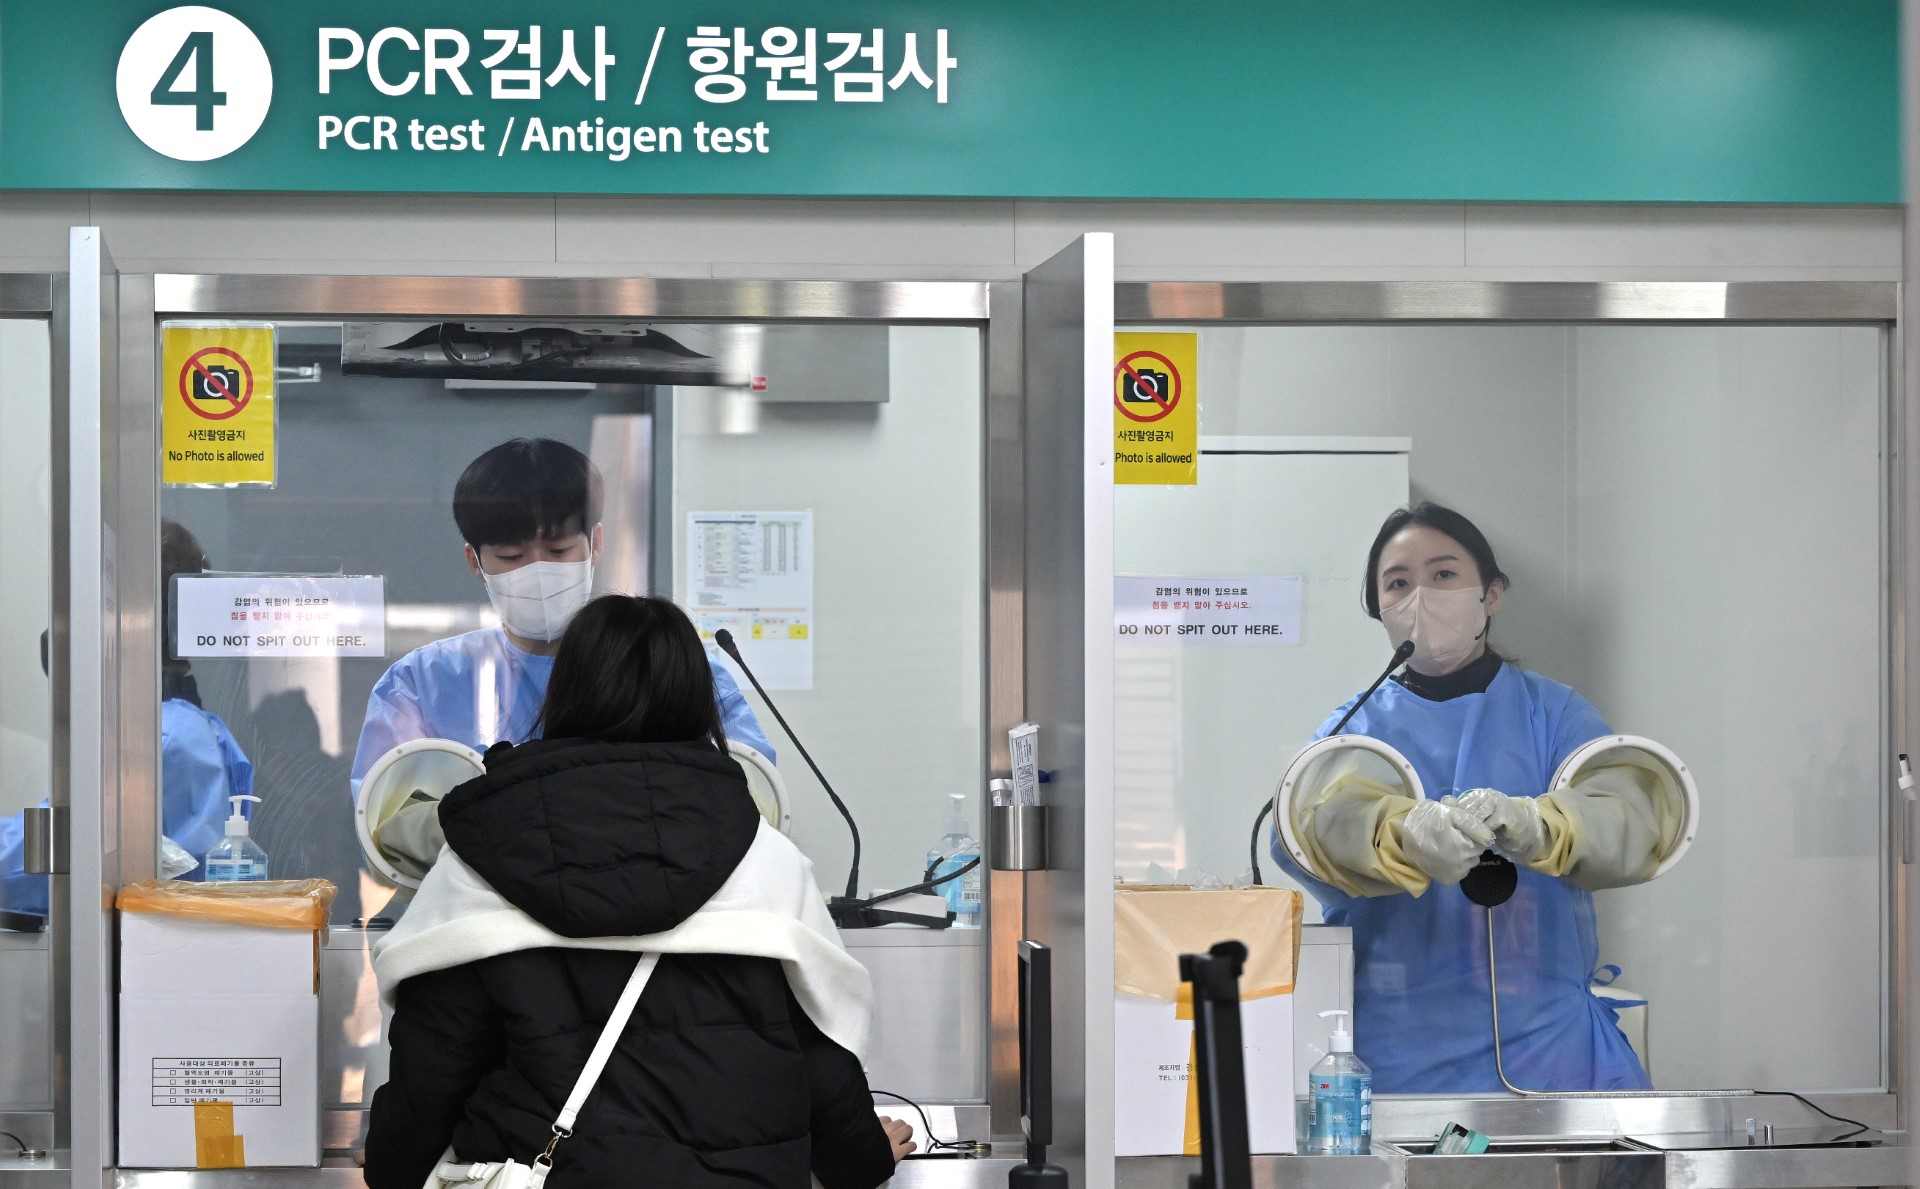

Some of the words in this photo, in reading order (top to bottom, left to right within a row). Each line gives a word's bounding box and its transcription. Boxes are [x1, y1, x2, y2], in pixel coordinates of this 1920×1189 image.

[319, 26, 615, 100] PCR검사
[635, 27, 665, 104] /
[687, 27, 957, 103] 항원검사
[151, 32, 226, 130] 4
[319, 116, 398, 150] PCR
[408, 119, 484, 150] test
[521, 117, 681, 161] Antigen
[694, 122, 769, 153] test
[188, 430, 245, 441] 사진촬영금지
[1118, 430, 1174, 442] 사진촬영금지
[169, 450, 182, 461] No
[185, 450, 214, 461] Photo
[216, 450, 224, 461] is
[227, 450, 264, 461] allowed
[1115, 452, 1144, 462] Photo
[1146, 452, 1154, 462] is
[1156, 452, 1192, 464] allowed
[1156, 587, 1180, 596] 감염의
[1185, 587, 1210, 596] 위험이
[1214, 587, 1248, 596] 있으므로
[234, 598, 260, 606] 감염의
[264, 598, 290, 606] 위험이
[295, 598, 329, 606] 있으므로
[230, 612, 248, 620] 침을
[1119, 624, 1138, 635] DO
[1144, 624, 1172, 635] NOT
[1177, 624, 1206, 635] SPIT
[1212, 624, 1238, 635] OUT
[1244, 624, 1283, 635] HERE.
[197, 636, 216, 646] DO
[223, 636, 250, 646] NOT
[257, 636, 286, 646] SPIT
[292, 636, 320, 646] OUT
[326, 636, 366, 646] HERE.
